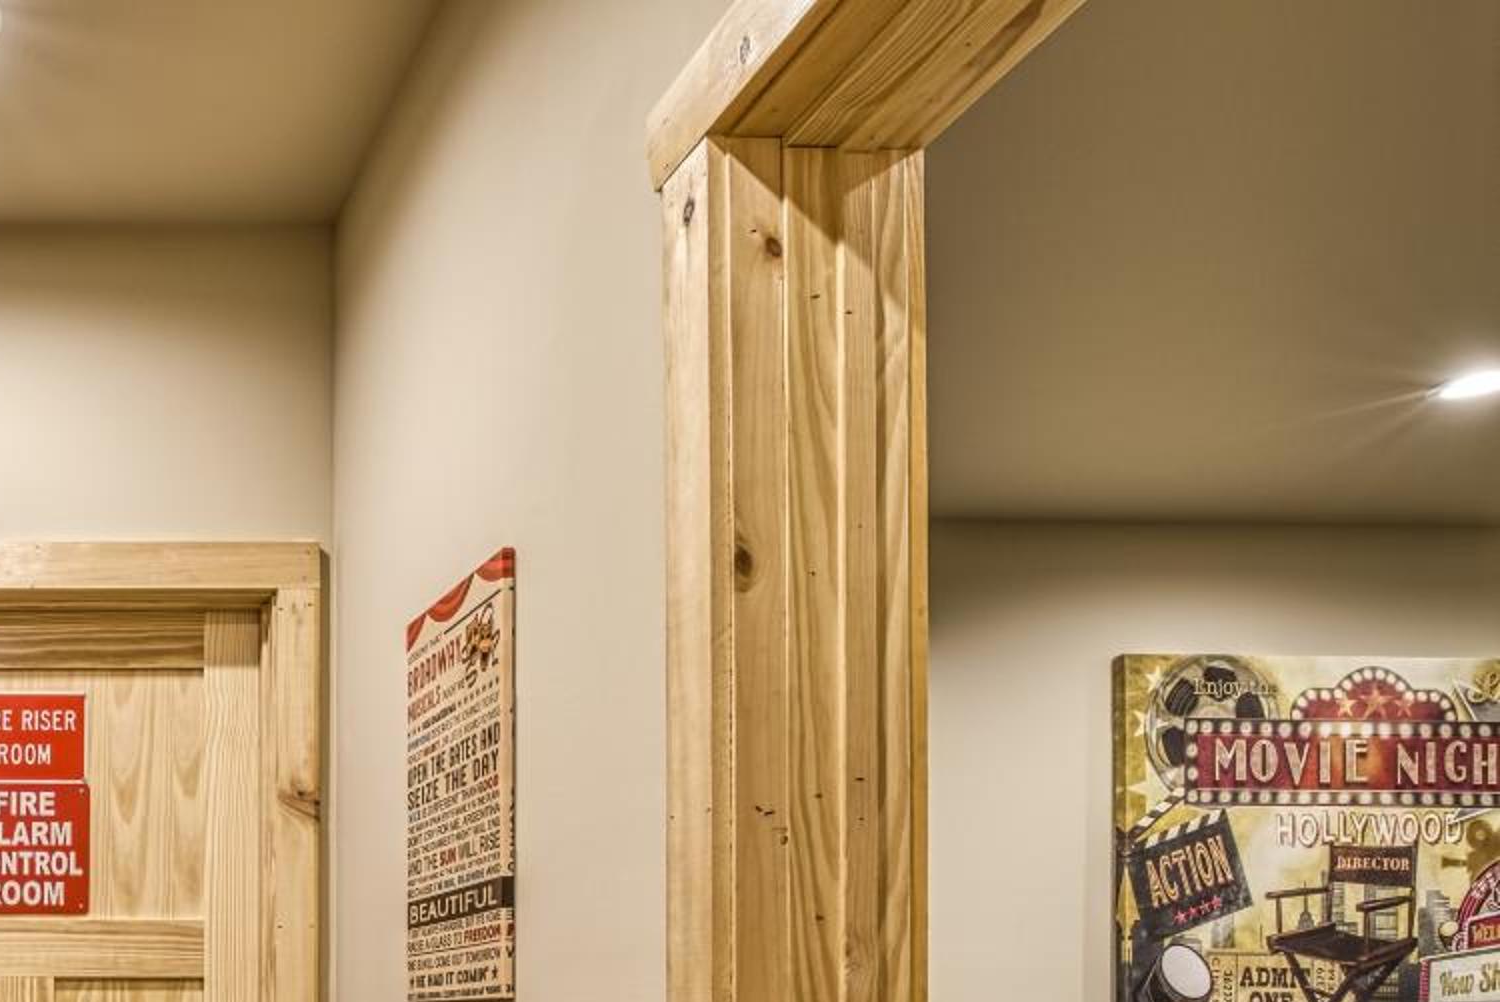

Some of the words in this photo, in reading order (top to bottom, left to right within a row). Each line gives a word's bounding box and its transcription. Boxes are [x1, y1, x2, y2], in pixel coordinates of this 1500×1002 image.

[1194, 678, 1241, 699] Enjoy
[21, 710, 76, 731] RISER
[408, 759, 428, 788] OPEN
[431, 749, 446, 777] THE
[450, 733, 477, 768] GATES
[480, 721, 500, 752] AND
[1215, 738, 1369, 785] MOVIE
[1397, 740, 1498, 785] NIGH
[408, 779, 438, 811] SEIZE
[445, 765, 467, 794] THE
[474, 750, 499, 782] DAY
[1275, 812, 1465, 846] HOLLYWOOD
[440, 844, 456, 867] SUN
[1145, 835, 1235, 907] ACTION
[1336, 854, 1410, 872] DIRECTOR
[409, 885, 498, 924] BEAUTIFUL
[464, 923, 500, 944] FREEDOM
